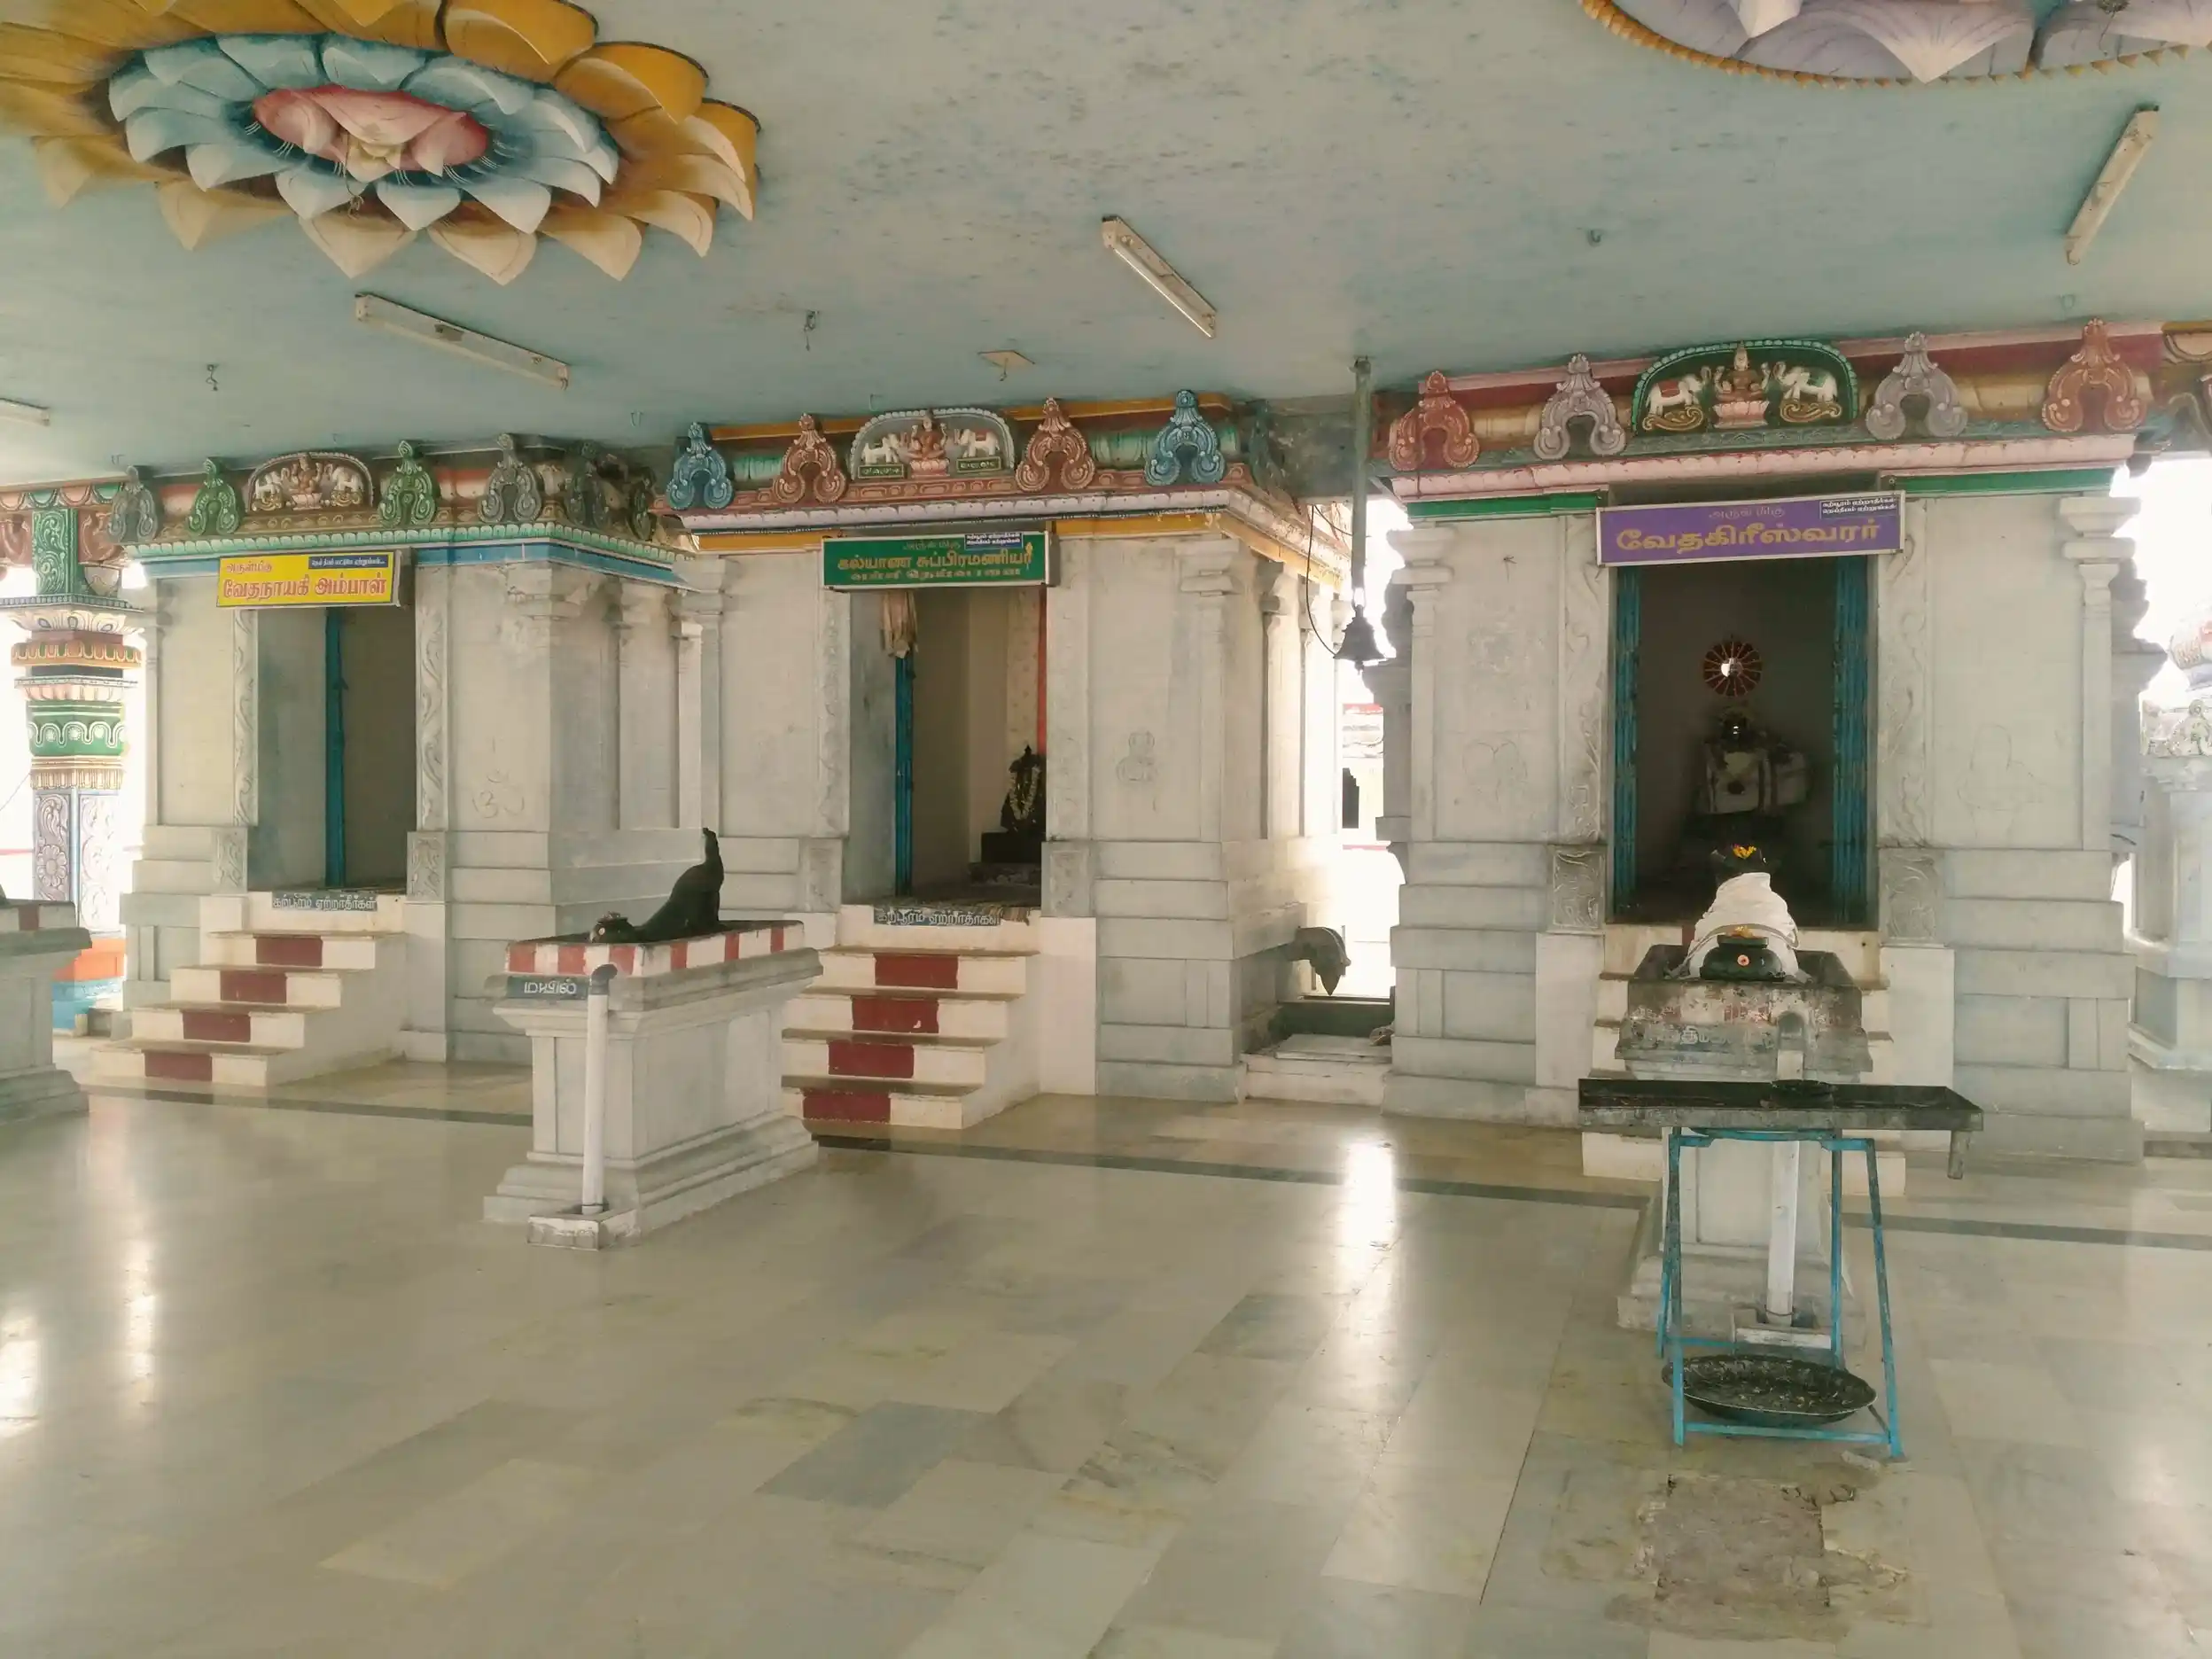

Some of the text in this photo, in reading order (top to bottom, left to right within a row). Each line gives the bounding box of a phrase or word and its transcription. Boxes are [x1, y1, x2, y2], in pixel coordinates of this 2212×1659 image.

[1616, 519, 1881, 554] வேதகிரீஸ்வரர்
[837, 554, 912, 572] கல்யாண
[223, 572, 387, 601] வேதநாயகி அம்பாள்
[524, 978, 578, 995] மயில்
